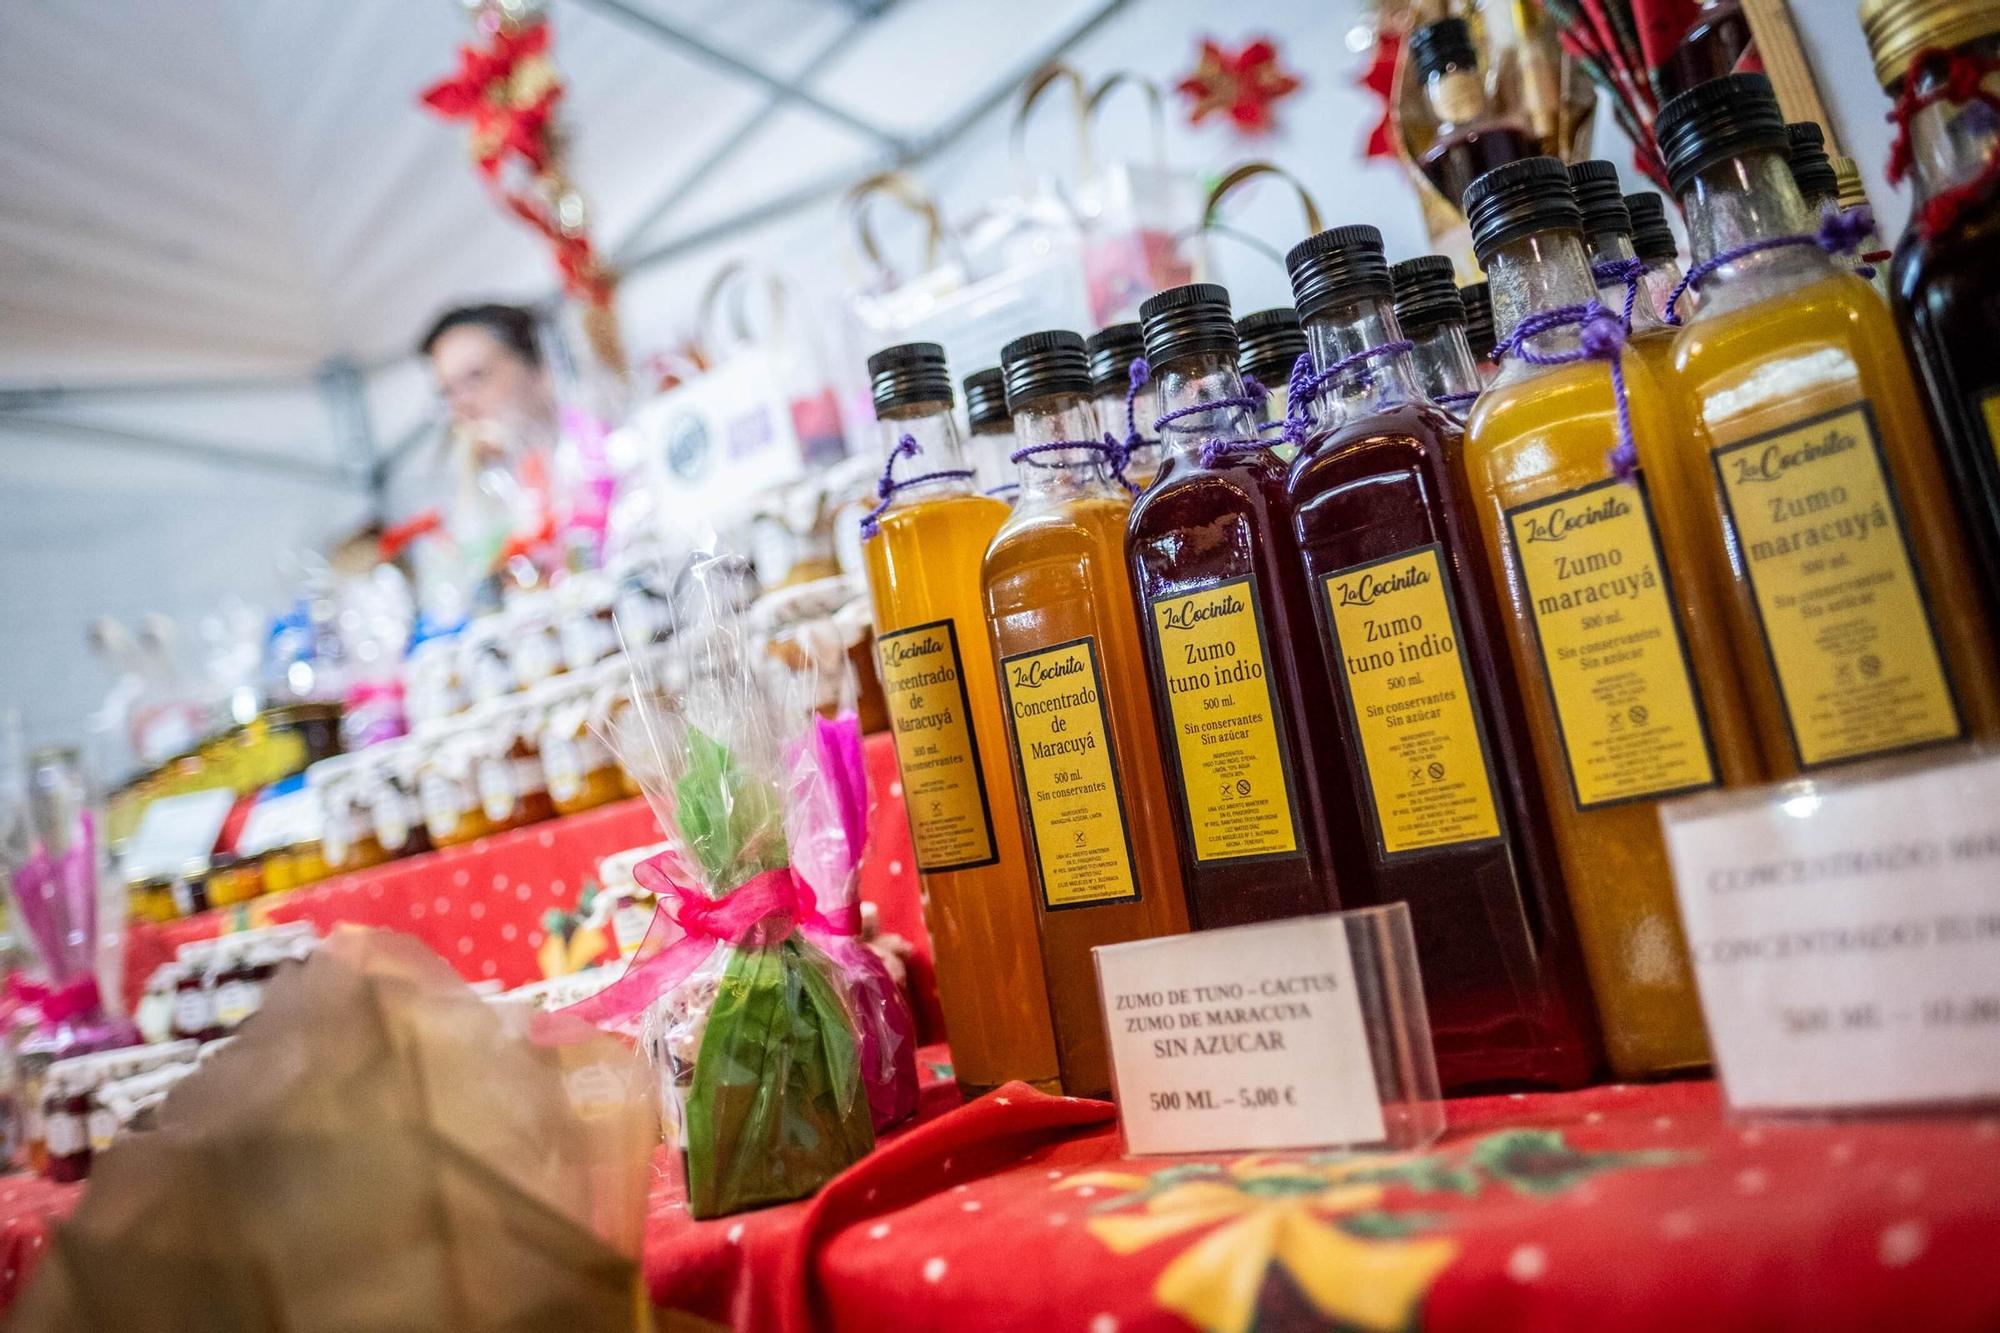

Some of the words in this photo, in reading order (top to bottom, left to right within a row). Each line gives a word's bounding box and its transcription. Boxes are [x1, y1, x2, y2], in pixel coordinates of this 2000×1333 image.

[1768, 486, 1847, 523] Zumo
[1751, 502, 1888, 561] maracuyá
[1554, 549, 1623, 580] Zumo
[1538, 564, 1656, 615] maracuyá
[1364, 614, 1422, 642] Zumo
[1185, 641, 1235, 665] Zumo
[1347, 650, 1394, 675] tuno
[1398, 633, 1453, 663] indio
[1169, 673, 1210, 694] tuno
[1214, 659, 1262, 686] indio
[1387, 676, 1406, 690] 500
[909, 693, 923, 710] de
[1015, 686, 1096, 718] Concentrado
[1203, 698, 1219, 711] 500
[1366, 705, 1384, 718] Sin
[1385, 691, 1457, 714] conservantes
[1051, 715, 1067, 733] de
[1184, 723, 1200, 735] Sin
[1201, 712, 1263, 733] conservantes
[1385, 715, 1404, 728] Sin
[1406, 708, 1442, 724] azúcar
[1031, 731, 1096, 760] Maracuyá
[1201, 734, 1217, 745] Sin
[1218, 729, 1250, 743] azúcar
[1037, 790, 1051, 801] Sin
[1051, 781, 1107, 800] conservantes
[1054, 771, 1069, 784] 500
[1116, 992, 1164, 1011] ZUMO
[1169, 988, 1190, 1005] DE
[1192, 983, 1243, 1003] TUNO
[1260, 973, 1338, 997] CACTUS
[1125, 1013, 1175, 1033] ZUMO
[1180, 1010, 1202, 1028] DE
[1207, 1003, 1312, 1026] MARACUYA
[1153, 1037, 1187, 1058] SIN
[1193, 1031, 1286, 1055] AZUCAR
[1150, 1091, 1181, 1111] 500
[1185, 1090, 1219, 1110] ML
[1284, 1085, 1298, 1106] €
